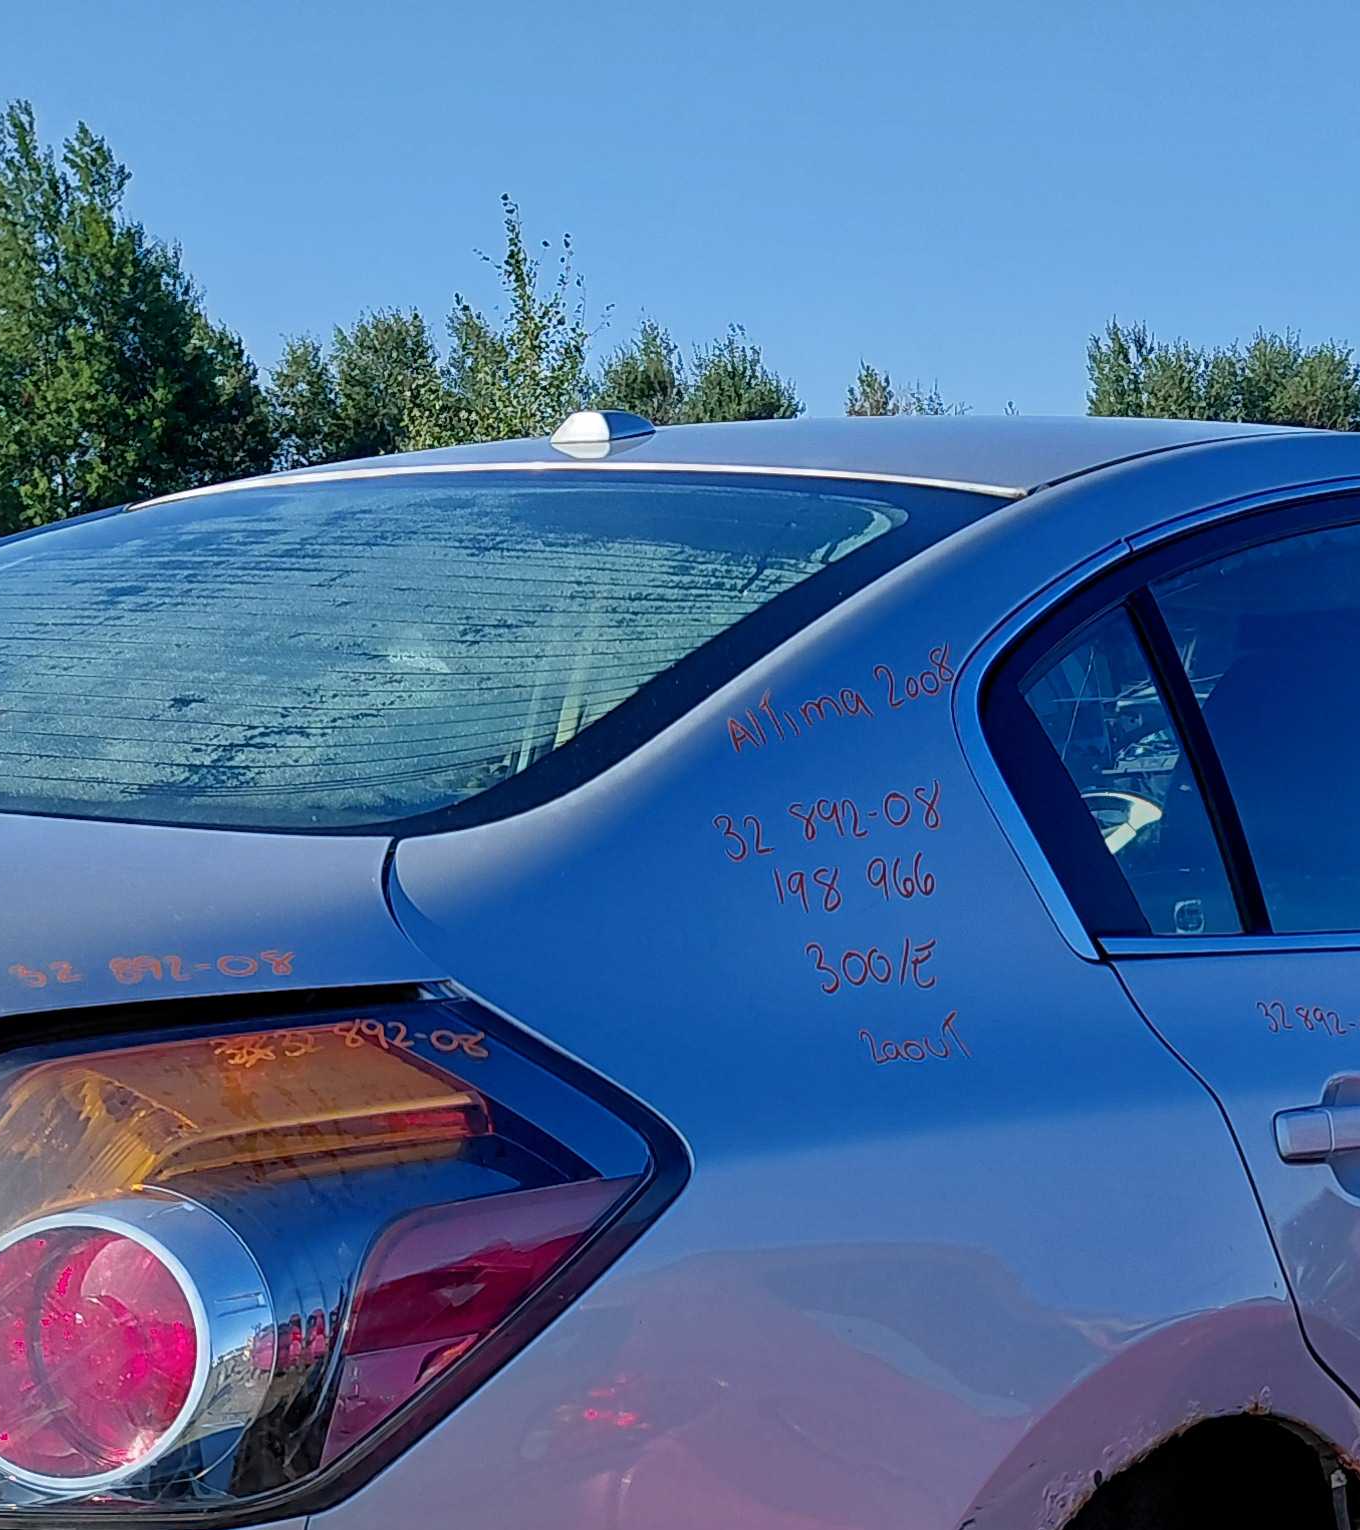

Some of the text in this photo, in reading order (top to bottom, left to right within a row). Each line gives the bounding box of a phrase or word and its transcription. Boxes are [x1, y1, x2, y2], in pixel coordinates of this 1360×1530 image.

[873, 641, 956, 708] 2008
[713, 779, 940, 861] 32 892-08
[773, 852, 936, 913] 198 966
[9, 961, 82, 988] 32
